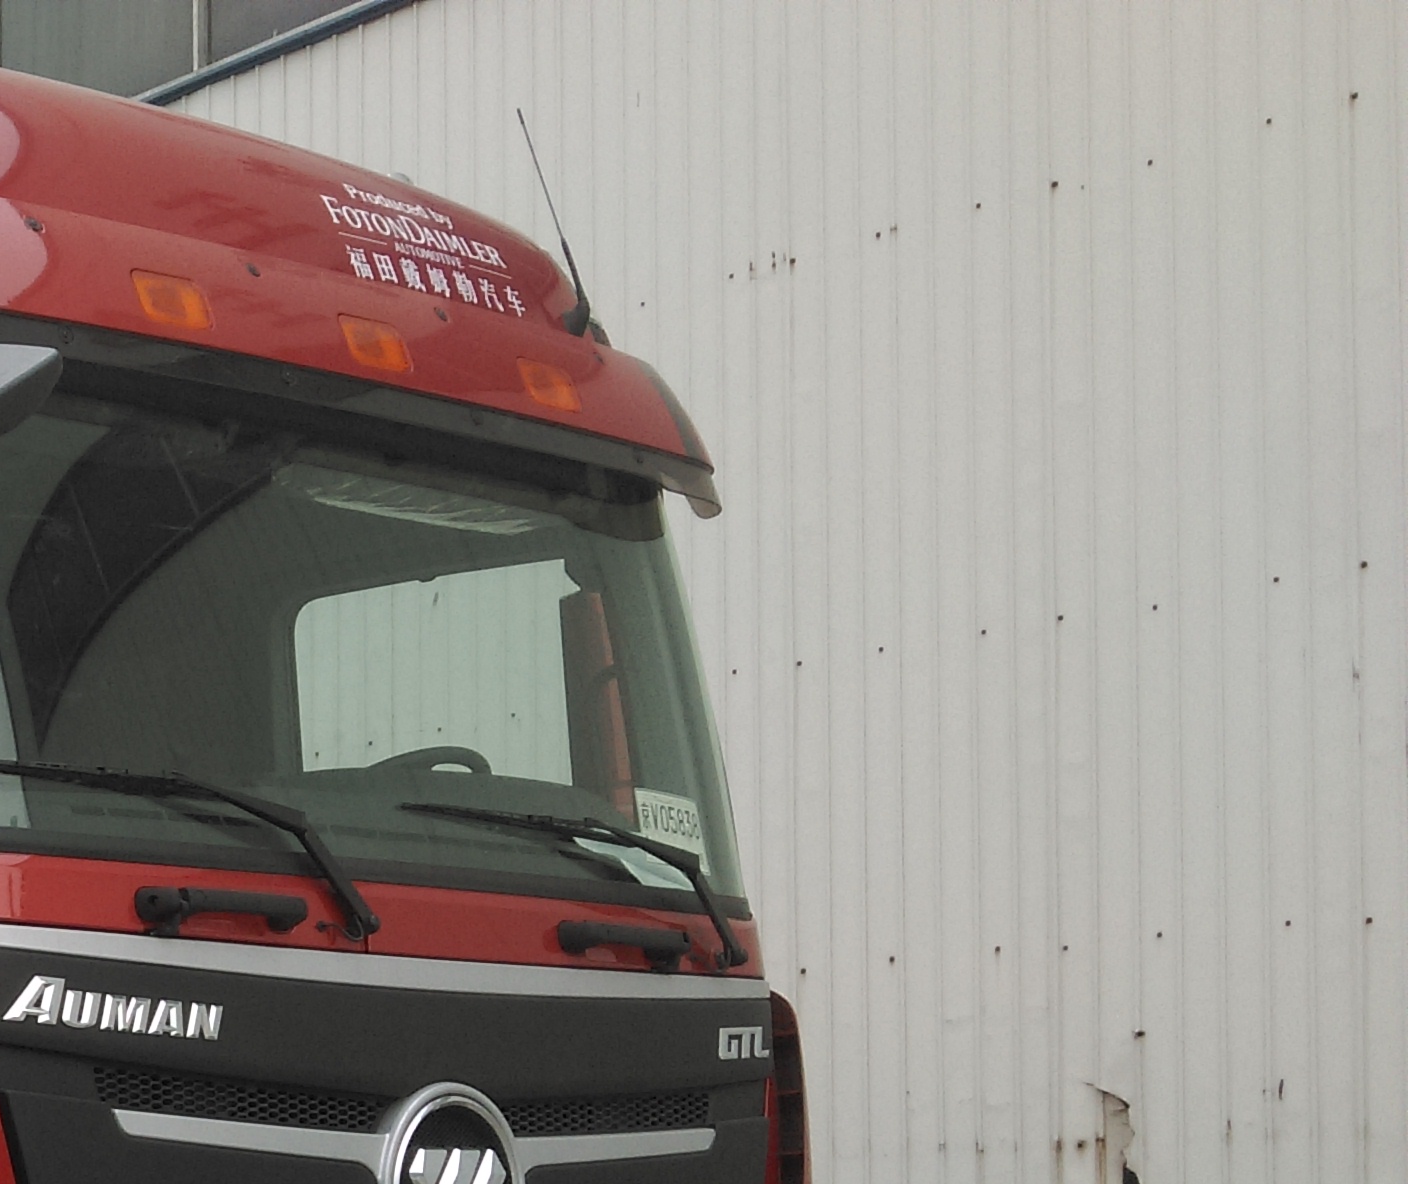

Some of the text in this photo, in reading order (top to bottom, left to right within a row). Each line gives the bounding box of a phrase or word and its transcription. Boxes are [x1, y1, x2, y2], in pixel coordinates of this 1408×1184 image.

[342, 183, 454, 230] Produced by
[394, 241, 465, 270] AUTOMOTIVE
[345, 243, 526, 318] 福田戴姆勒汽车
[2, 974, 224, 1042] AUMAN
[717, 1025, 771, 1060] GTL
